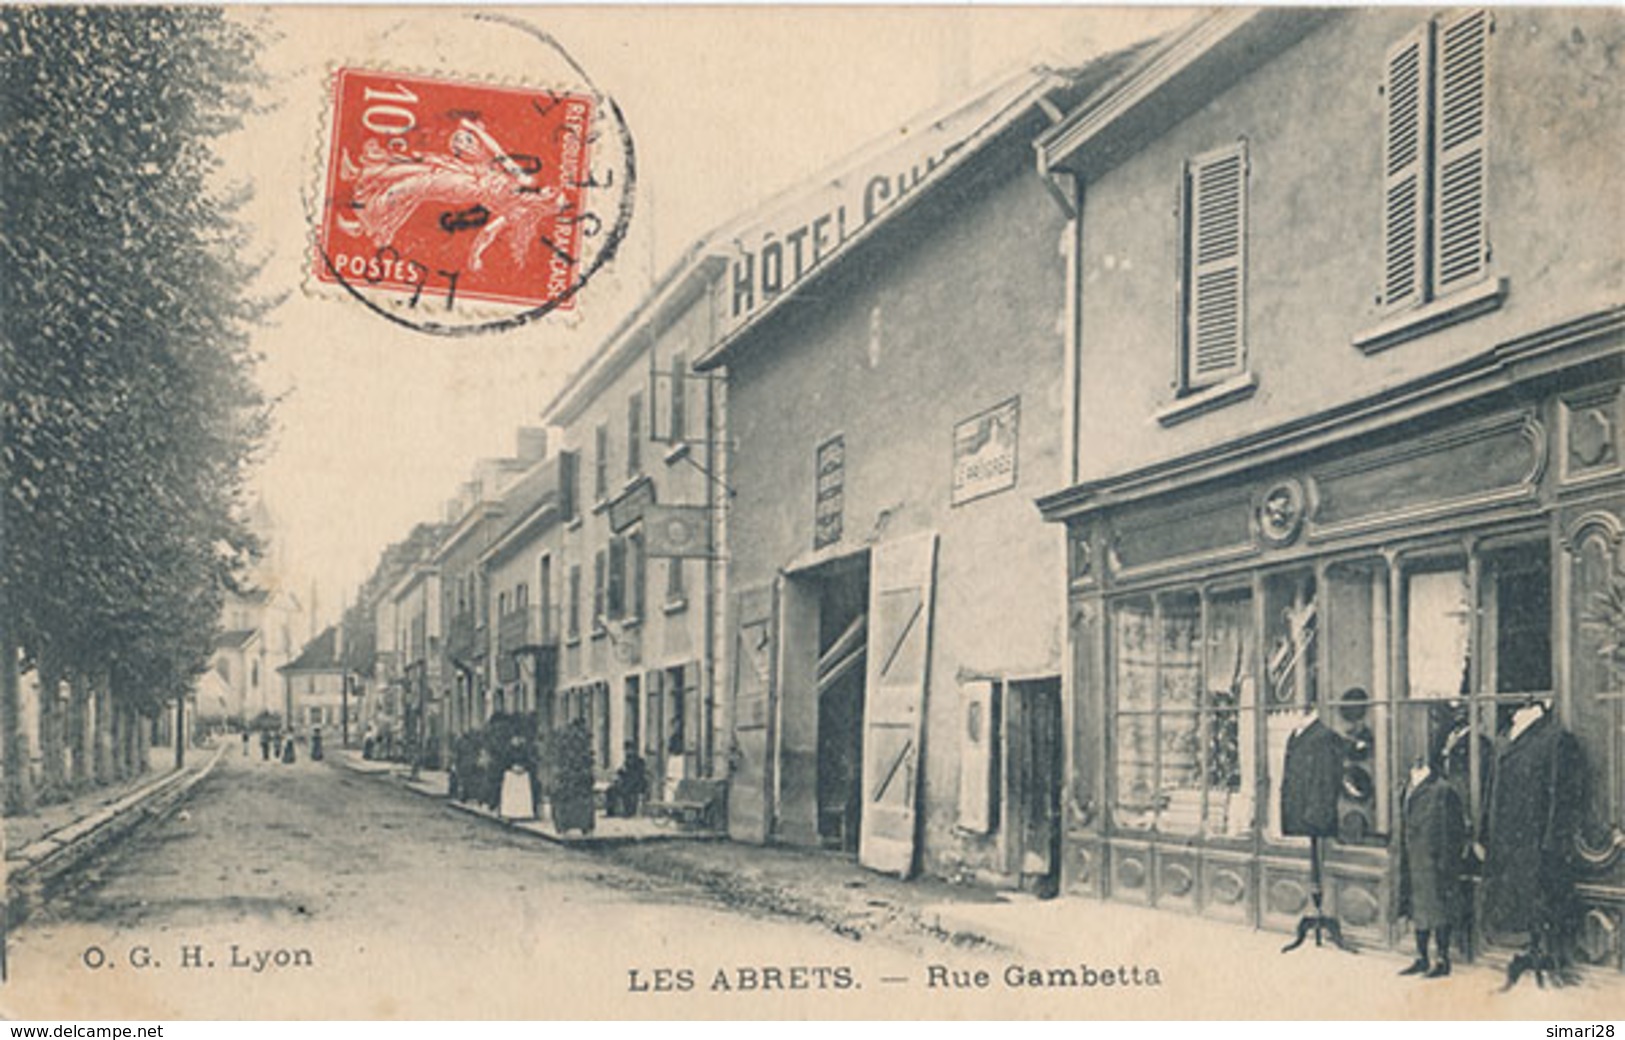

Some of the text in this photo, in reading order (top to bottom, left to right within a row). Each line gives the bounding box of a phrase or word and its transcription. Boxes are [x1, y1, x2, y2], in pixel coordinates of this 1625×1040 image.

[334, 253, 419, 284] POSTES
[83, 945, 313, 973] O. G. H. Lyon
[628, 969, 695, 992] LES
[711, 966, 862, 991] ABRETS.
[927, 965, 990, 988] Rue
[1003, 964, 1162, 988] Gambetta
